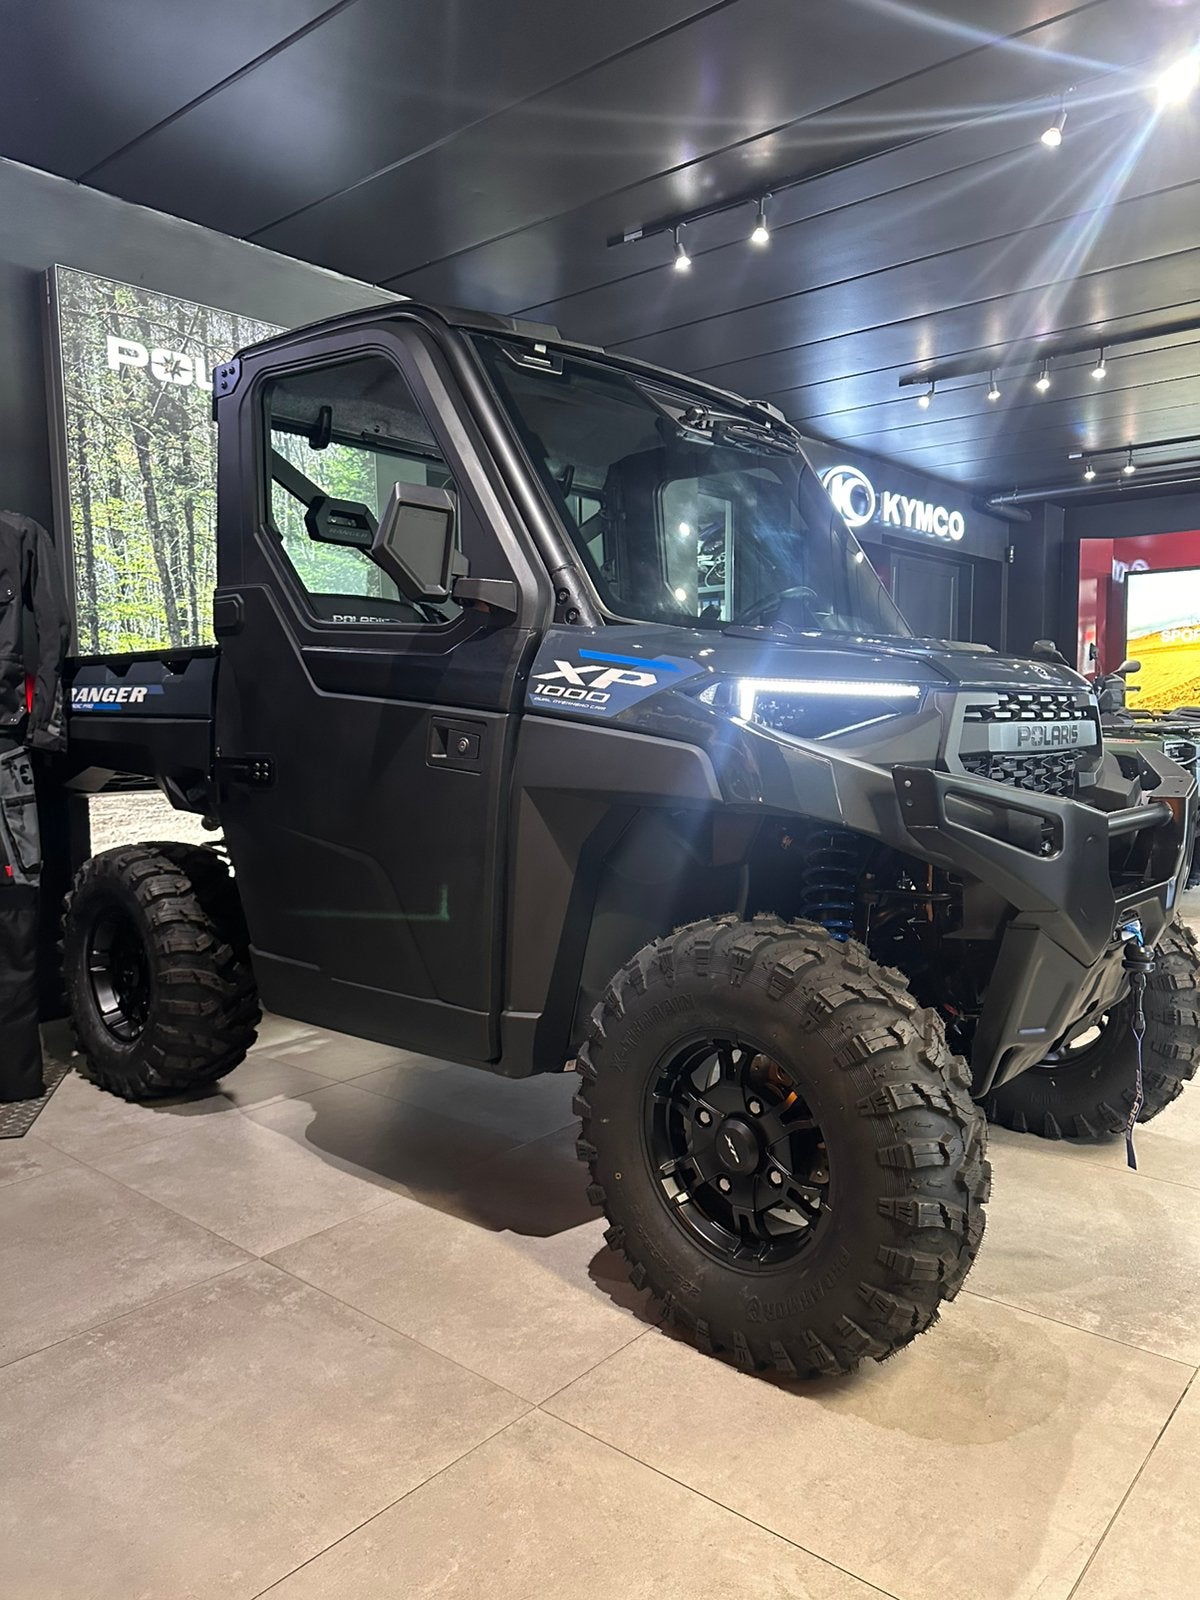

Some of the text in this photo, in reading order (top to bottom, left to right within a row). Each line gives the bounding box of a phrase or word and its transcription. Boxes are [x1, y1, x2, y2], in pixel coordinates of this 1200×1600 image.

[882, 490, 965, 541] KYMCO
[329, 528, 368, 538] RANGER
[532, 660, 658, 689] XP
[534, 684, 611, 703] 1000
[1017, 725, 1078, 747] POLARIS
